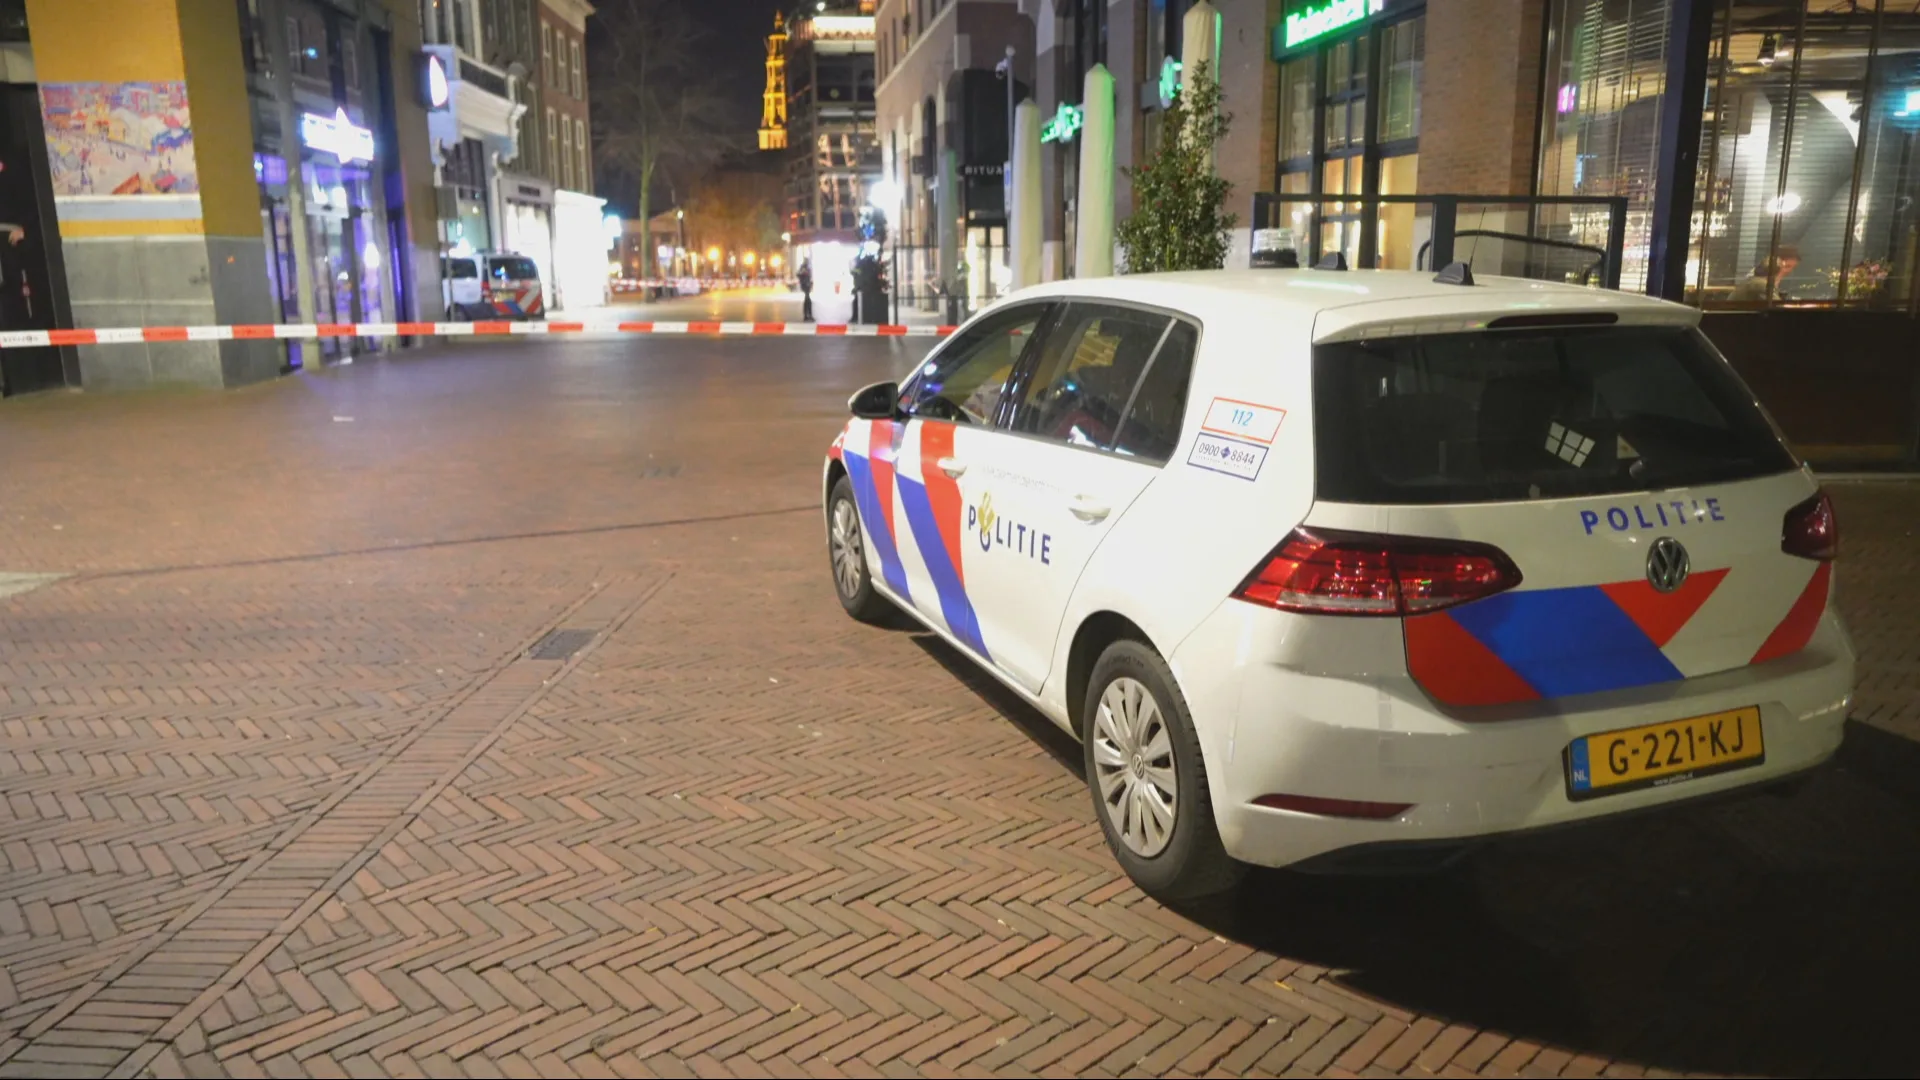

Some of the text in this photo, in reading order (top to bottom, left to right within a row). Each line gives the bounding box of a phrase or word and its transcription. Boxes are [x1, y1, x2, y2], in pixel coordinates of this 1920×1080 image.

[964, 165, 1004, 176] RITUA
[1231, 408, 1254, 427] 112
[1198, 442, 1220, 457] 0900
[1230, 449, 1256, 465] 8844
[1580, 498, 1725, 536] POLITIE
[968, 504, 1052, 566] POLITIE
[1609, 716, 1744, 776] G-221-KJ
[1573, 771, 1588, 782] NL
